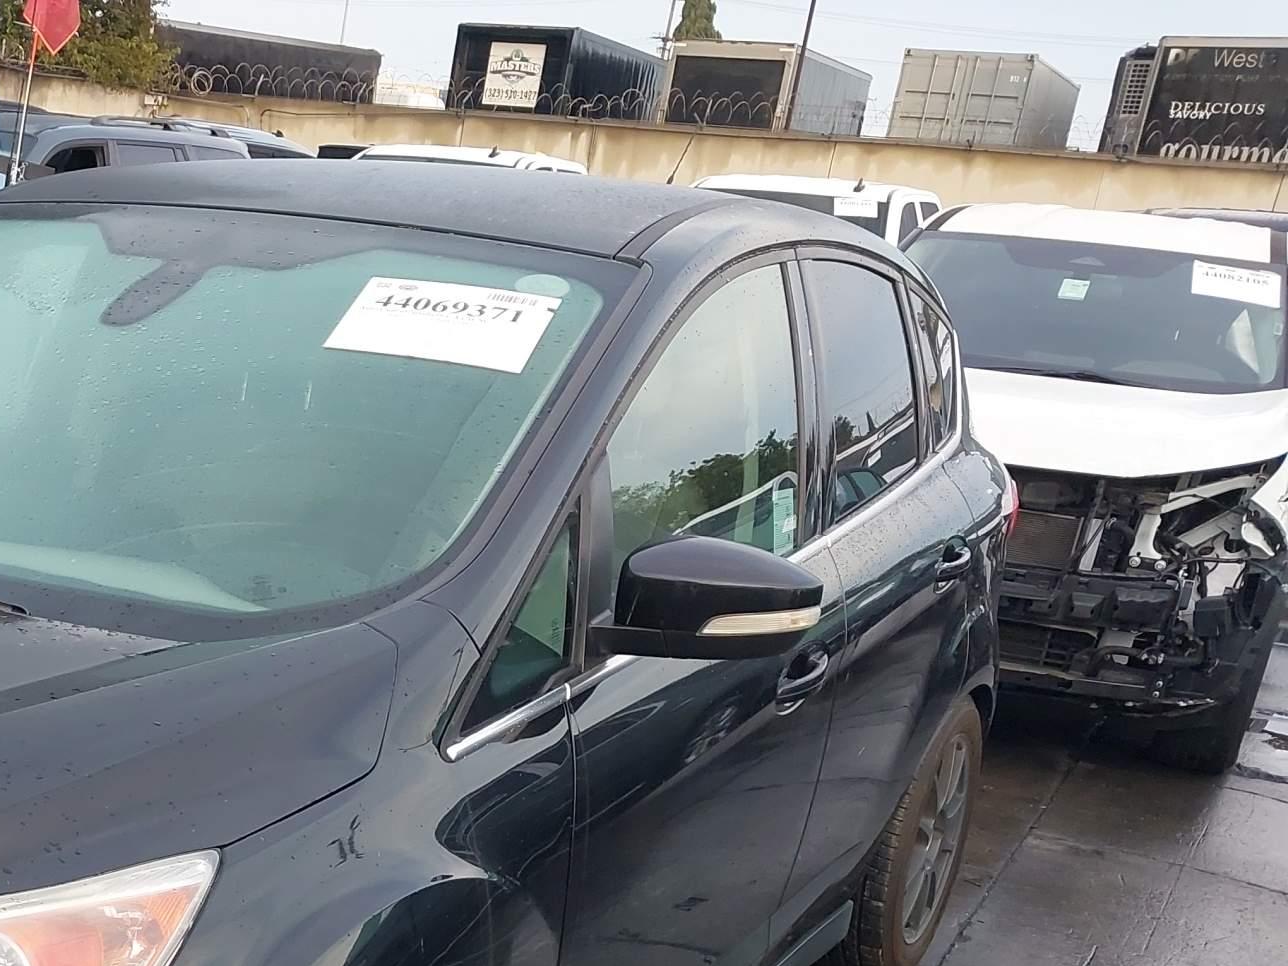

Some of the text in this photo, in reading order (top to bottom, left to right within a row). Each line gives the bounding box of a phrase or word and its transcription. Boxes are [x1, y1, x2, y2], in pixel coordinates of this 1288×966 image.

[490, 60, 541, 74] MASTERS
[1168, 111, 1212, 120] SAVORY
[1170, 101, 1266, 116] DELICIOUS
[375, 294, 524, 323] 44069371
